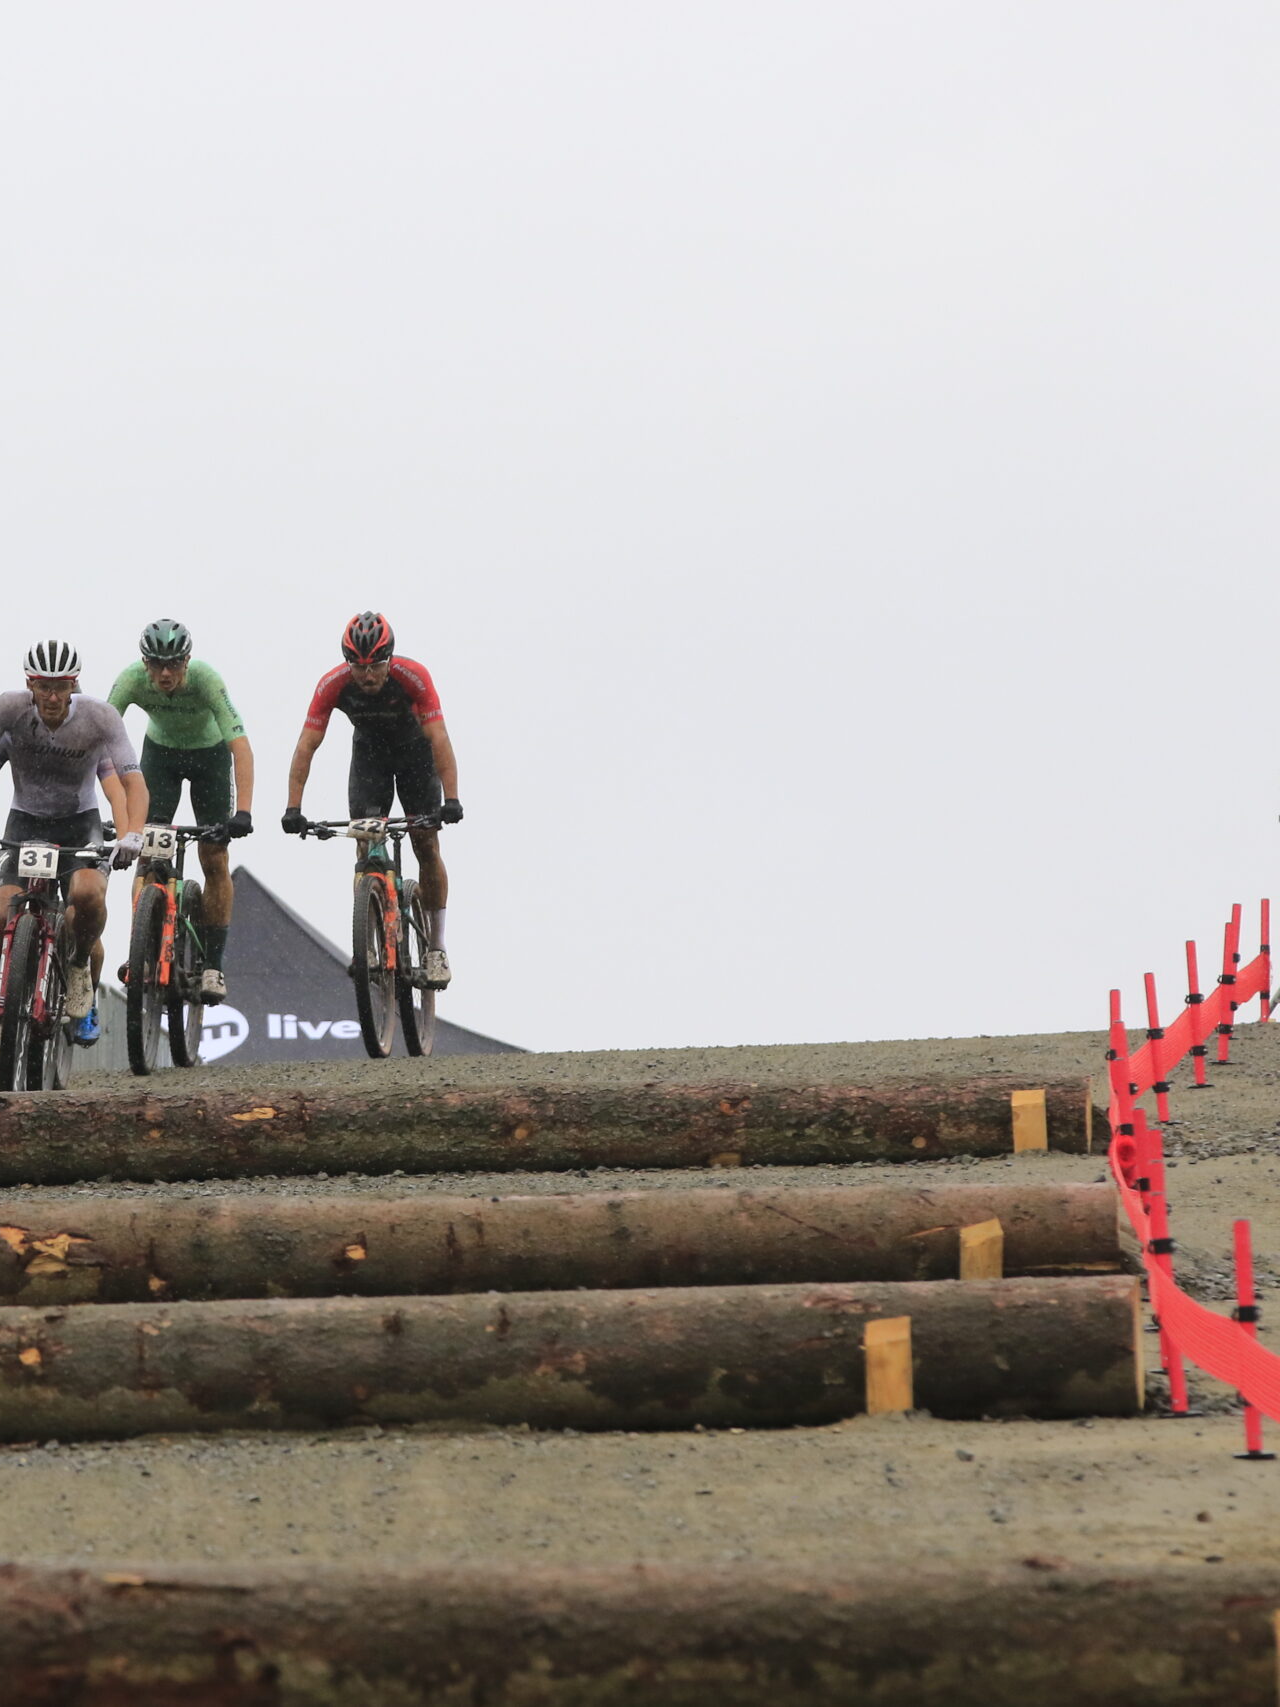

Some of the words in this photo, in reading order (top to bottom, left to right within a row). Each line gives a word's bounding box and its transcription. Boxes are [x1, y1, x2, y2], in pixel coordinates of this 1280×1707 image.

[352, 820, 381, 833] 22
[145, 831, 173, 849] 13
[22, 850, 53, 868] 31
[267, 1013, 362, 1040] live
